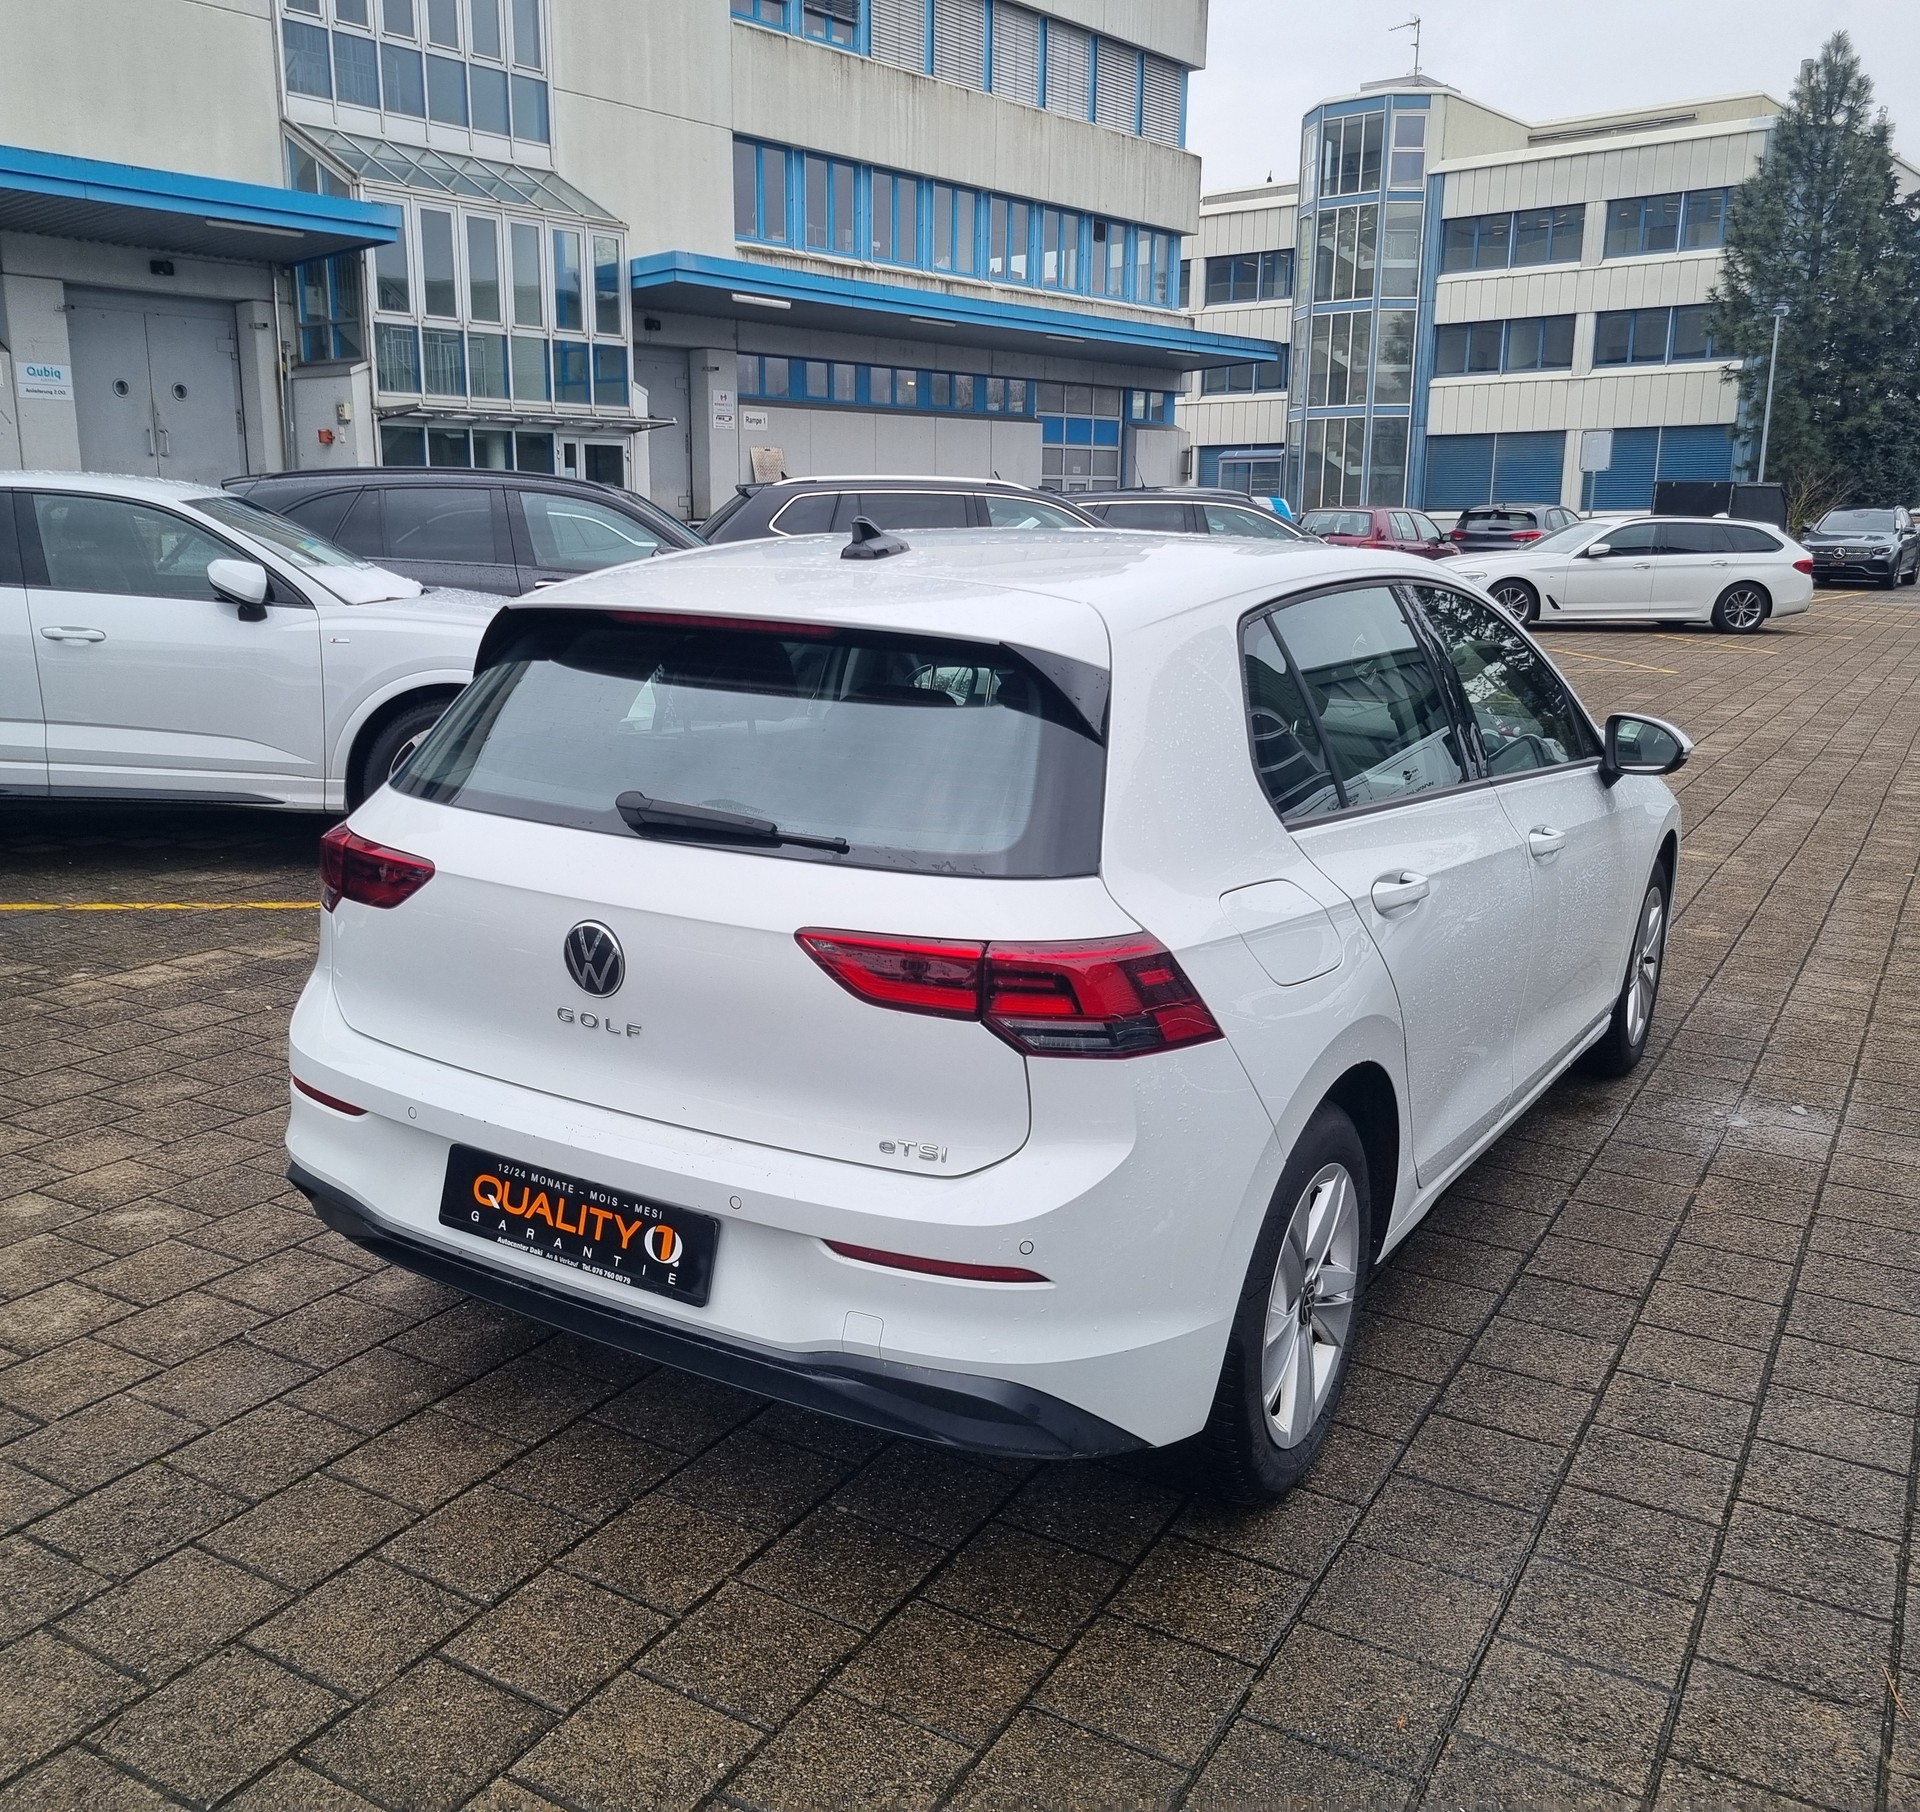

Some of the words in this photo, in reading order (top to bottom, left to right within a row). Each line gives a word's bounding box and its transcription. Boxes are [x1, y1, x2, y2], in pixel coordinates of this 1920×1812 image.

[26, 366, 61, 380] Qubiq
[745, 415, 762, 426] Rampe
[557, 1006, 642, 1037] GOLF
[879, 1139, 948, 1163] eTSI
[498, 1163, 526, 1179] 12/24
[530, 1172, 575, 1194] MONATE
[589, 1190, 618, 1207] MOIS
[634, 1203, 663, 1220] MESI
[473, 1174, 642, 1250] QUALITY
[471, 1210, 677, 1285] GARANTIE
[497, 1236, 529, 1252] Autocenter
[529, 1246, 543, 1256] Daki
[559, 1256, 579, 1268] Verkauf
[582, 1262, 592, 1272] Tel.
[592, 1265, 604, 1276] 076
[603, 1269, 615, 1280] 760
[615, 1274, 623, 1282] 00
[623, 1276, 631, 1285] 79
